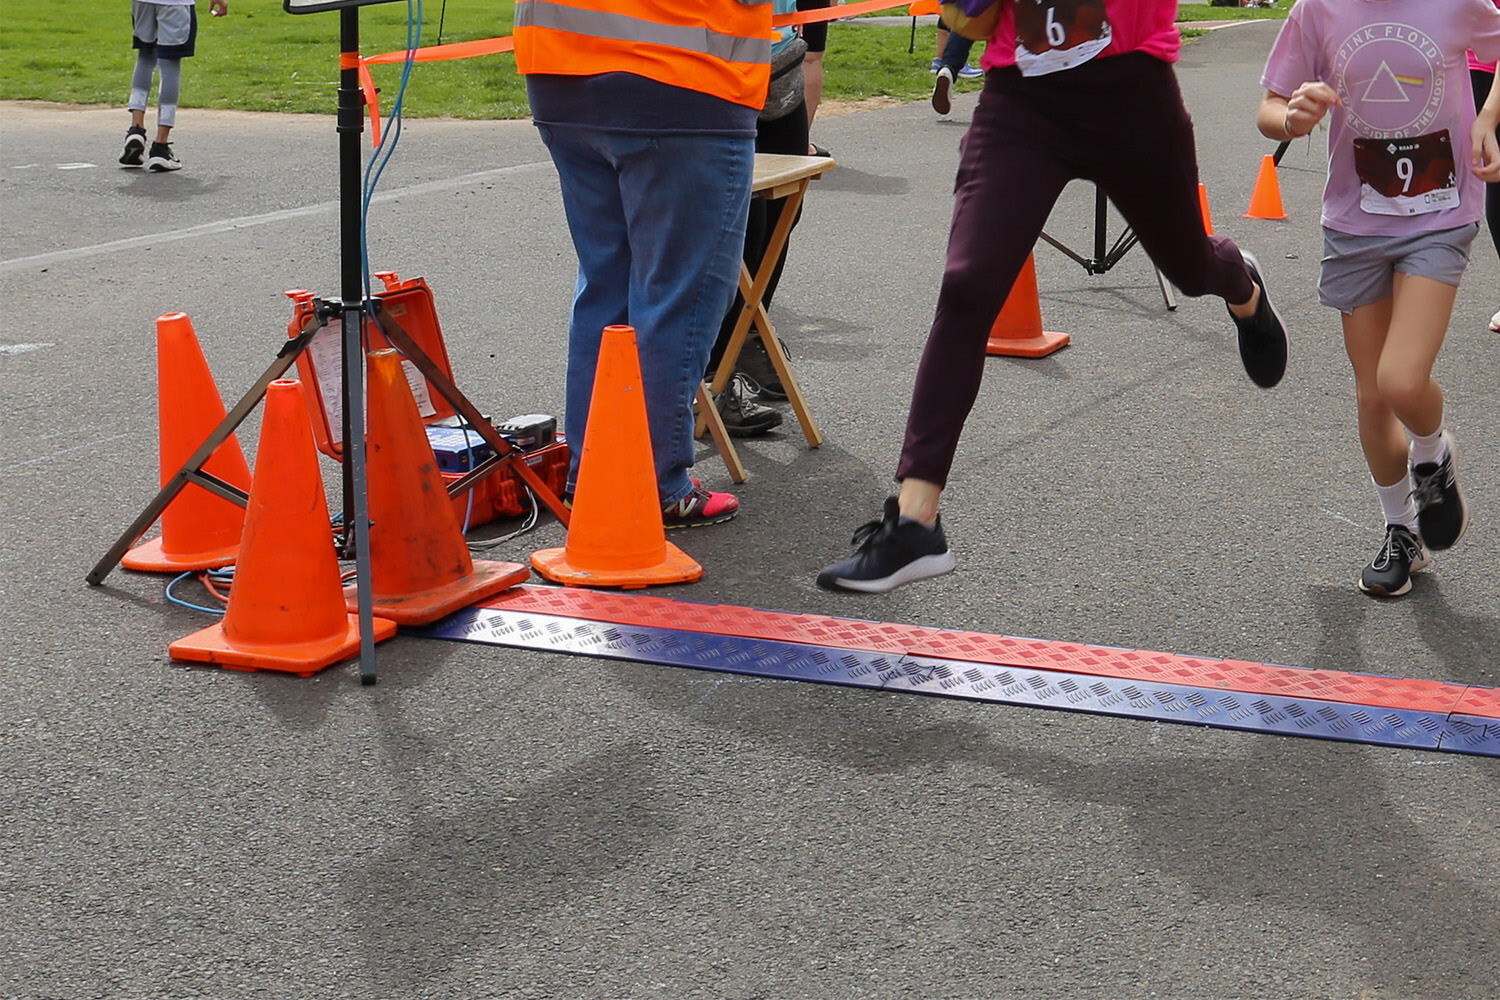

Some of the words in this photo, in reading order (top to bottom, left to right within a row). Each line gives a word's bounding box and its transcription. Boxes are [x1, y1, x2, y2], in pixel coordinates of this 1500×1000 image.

[1046, 7, 1066, 47] 6
[1340, 28, 1375, 60] PINK
[1385, 26, 1438, 59] FLOYD
[1362, 126, 1390, 139] SIDE
[1395, 129, 1410, 139] OF
[1413, 109, 1434, 132] THE
[1430, 70, 1443, 107] MOON
[1396, 157, 1414, 193] 9
